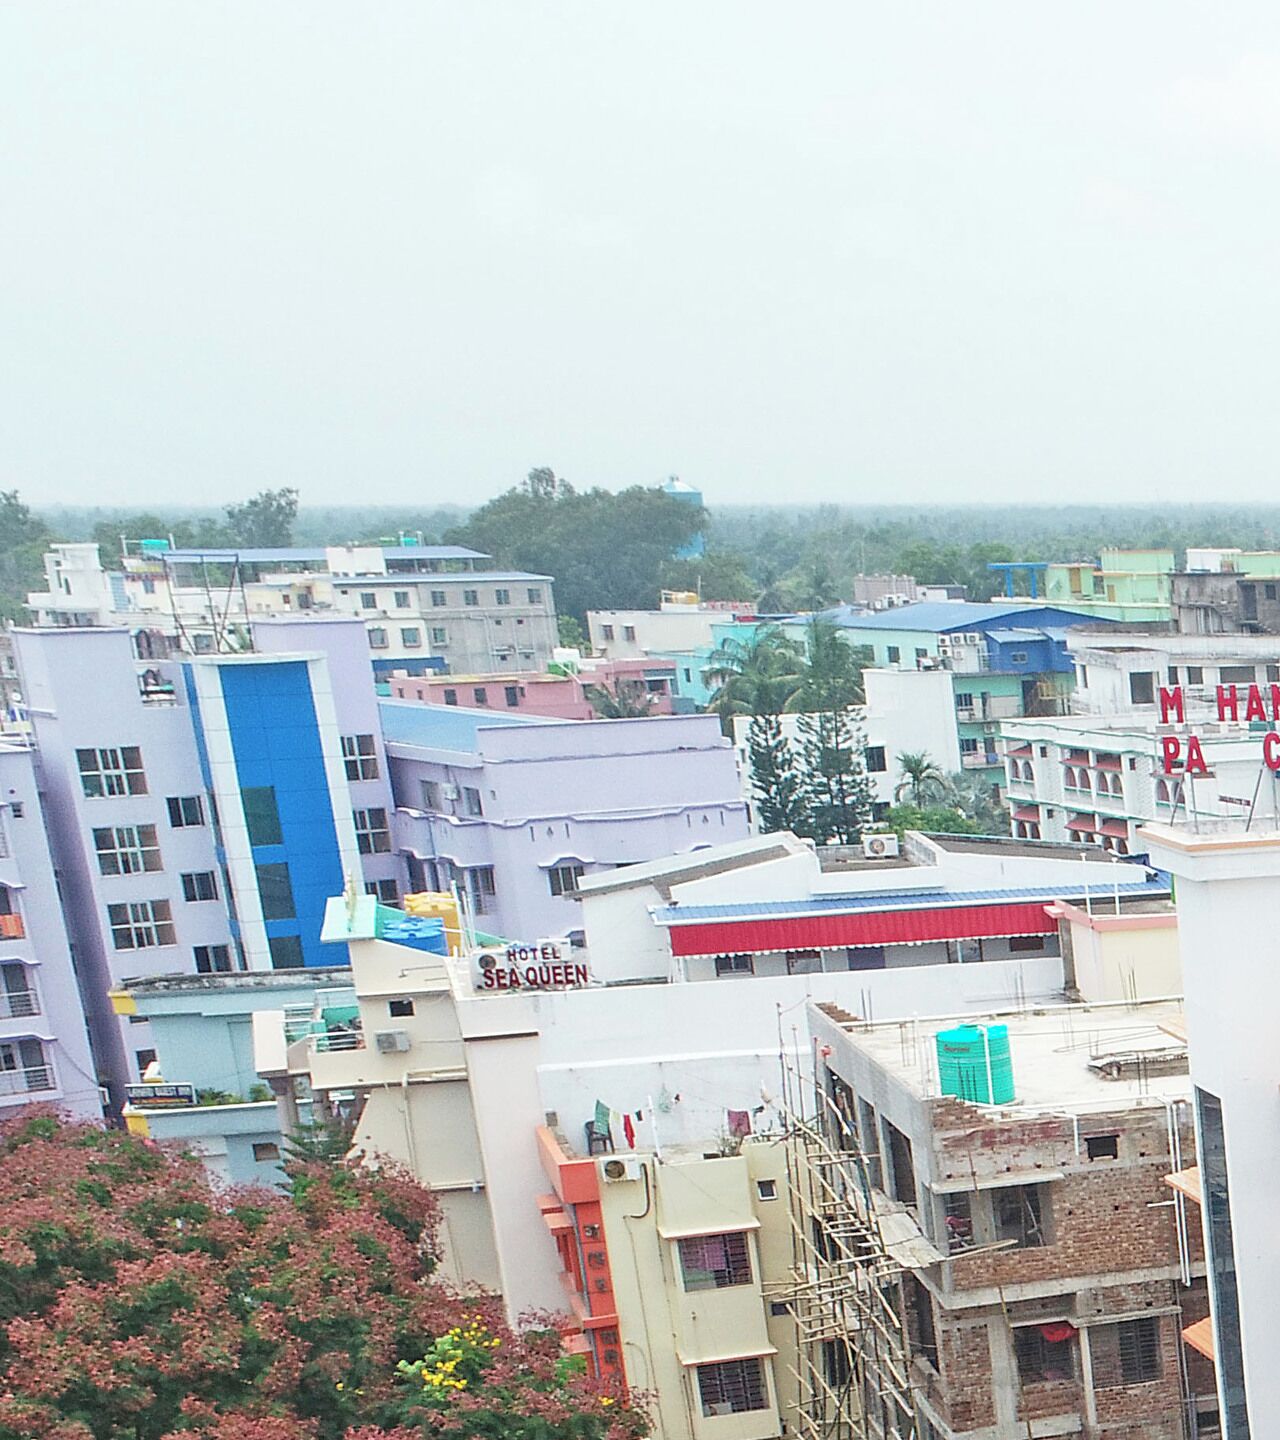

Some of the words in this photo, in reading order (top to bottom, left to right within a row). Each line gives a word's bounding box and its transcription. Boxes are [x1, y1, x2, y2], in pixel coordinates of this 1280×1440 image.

[507, 947, 561, 962] HOTEL
[483, 966, 521, 989] SEA
[525, 964, 588, 986] QUEEN
